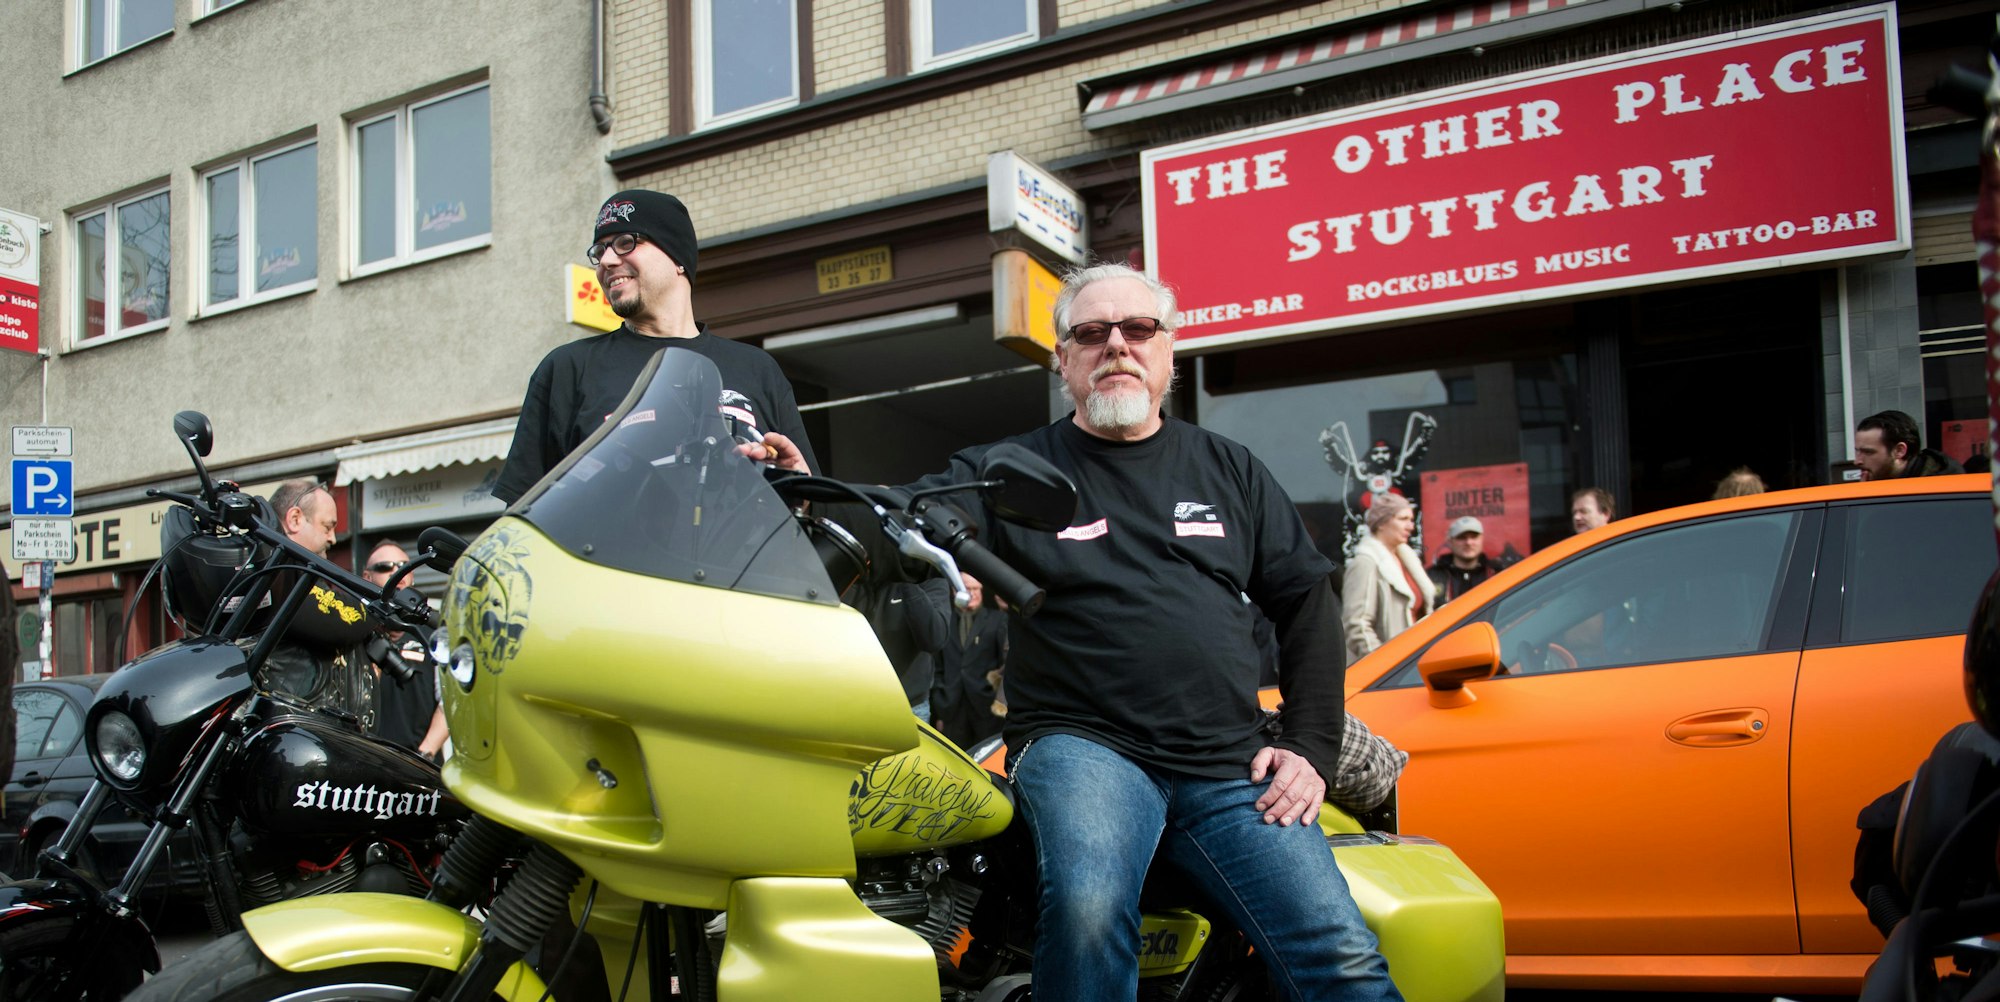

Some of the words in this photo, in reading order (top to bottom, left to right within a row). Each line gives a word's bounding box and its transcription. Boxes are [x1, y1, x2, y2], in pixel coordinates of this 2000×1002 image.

[1166, 150, 1289, 205] THE
[1332, 99, 1563, 174] OTHER
[1612, 39, 1868, 124] PLACE
[1287, 154, 1715, 262] STUTTGART
[828, 275, 840, 289] 33
[848, 271, 860, 285] 35
[870, 266, 881, 280] 37
[1176, 293, 1304, 328] BIKER-BAR
[1347, 260, 1518, 302] ROCK&BLUES
[1535, 244, 1631, 274] MUSIC
[1672, 209, 1877, 255] TATTOO-BAR
[11, 295, 38, 309] kiste
[26, 466, 58, 509] P
[373, 481, 443, 500] STUTTGARTER
[1445, 486, 1504, 507] UNTER
[385, 494, 431, 509] ZEITUNG
[24, 530, 61, 538] Parkschein
[29, 521, 41, 529] nur
[44, 521, 56, 529] mit
[1080, 523, 1106, 537] ANGELS
[17, 549, 26, 557] Sa
[293, 780, 441, 820] stuttgart
[869, 802, 973, 842] DEAD
